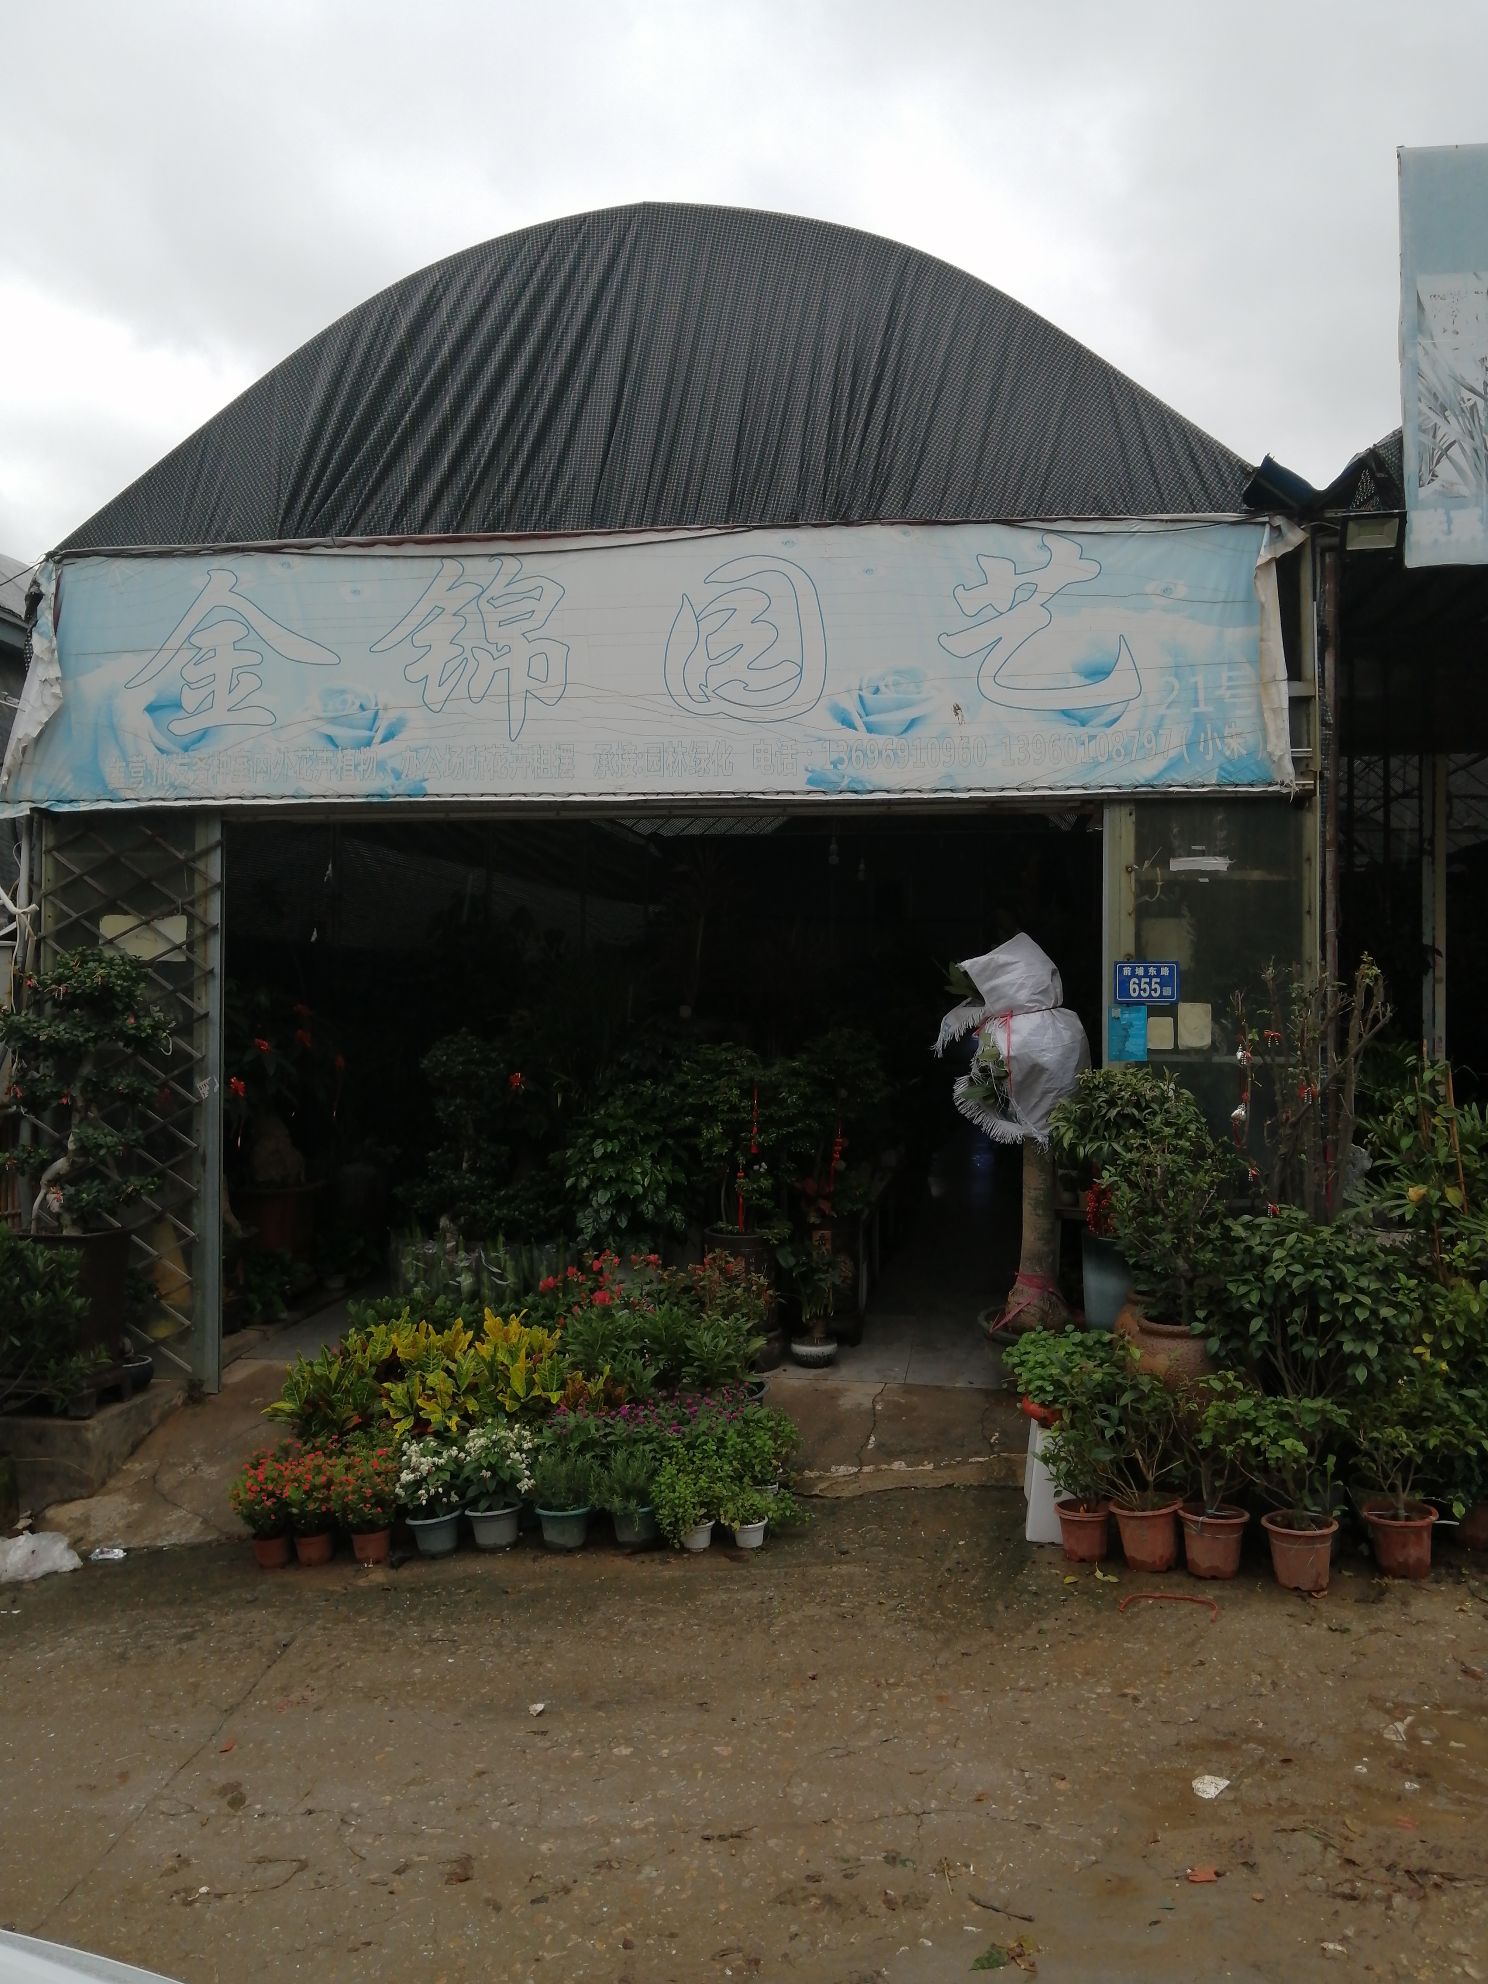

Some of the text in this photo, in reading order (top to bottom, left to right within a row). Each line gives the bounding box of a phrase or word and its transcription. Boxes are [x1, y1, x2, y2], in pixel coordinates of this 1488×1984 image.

[1122, 966, 1170, 976] 前埔东路
[1129, 977, 1161, 998] 655
